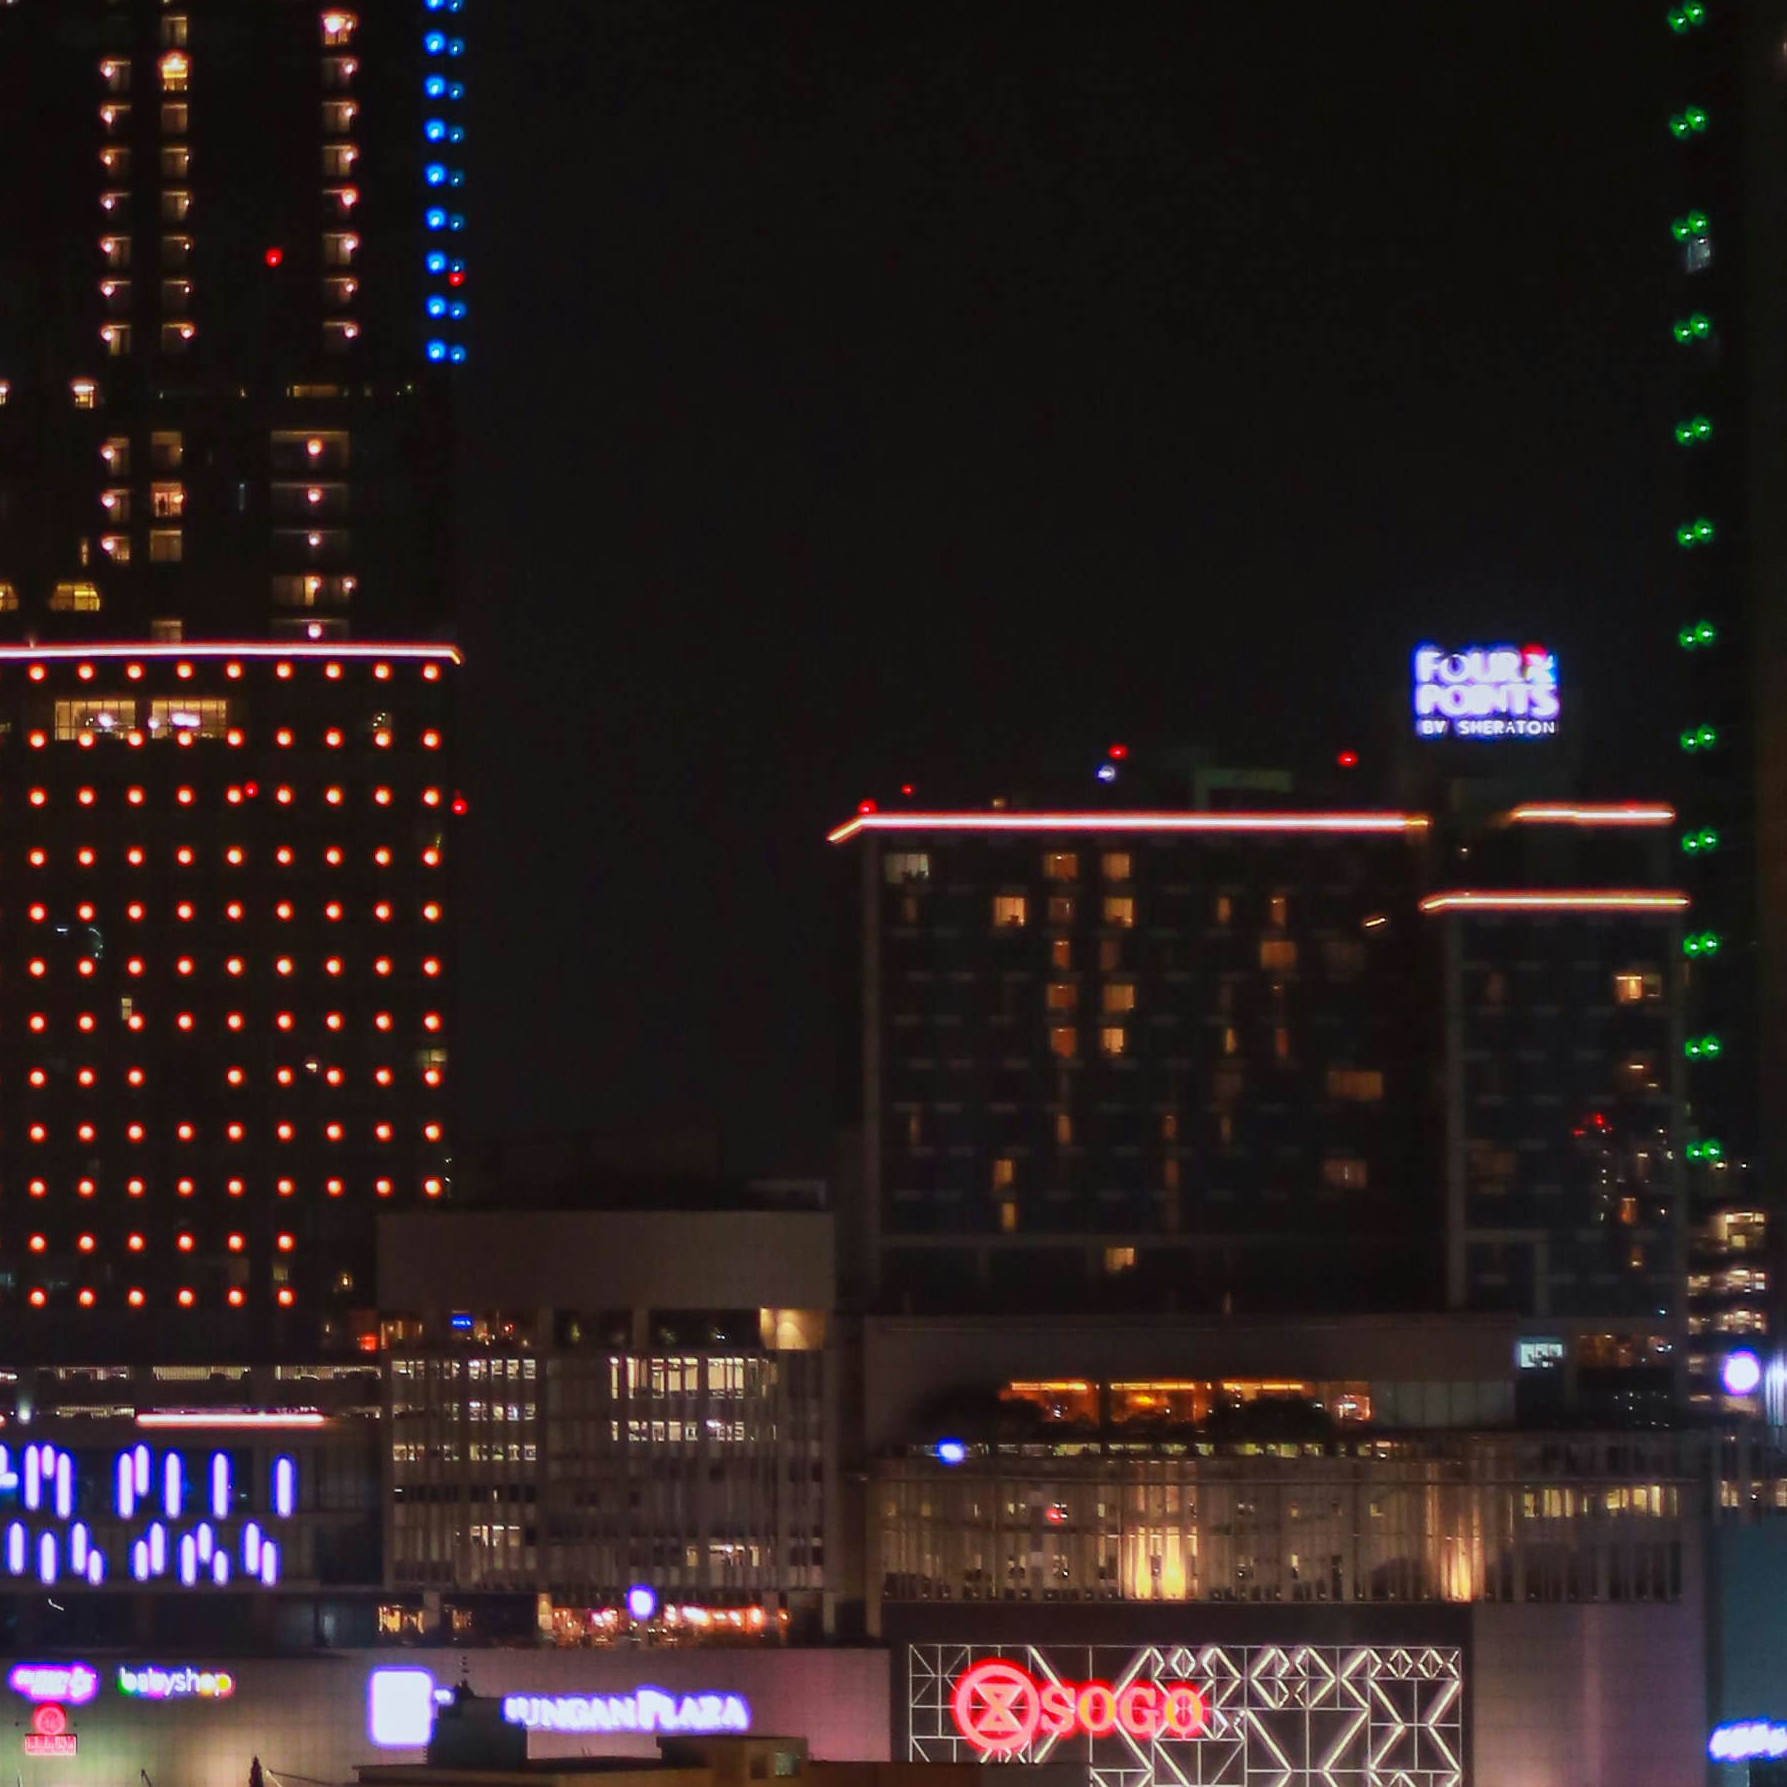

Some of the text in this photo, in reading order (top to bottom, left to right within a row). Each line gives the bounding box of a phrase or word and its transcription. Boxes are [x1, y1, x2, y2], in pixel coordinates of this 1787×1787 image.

[1416, 652, 1523, 682] FOUR
[1417, 684, 1558, 715] POINTS
[1422, 720, 1555, 734] BY SHERATON
[119, 1667, 233, 1697] babyshop
[636, 1689, 749, 1730] PLAZA
[1041, 1685, 1204, 1736] SOGO
